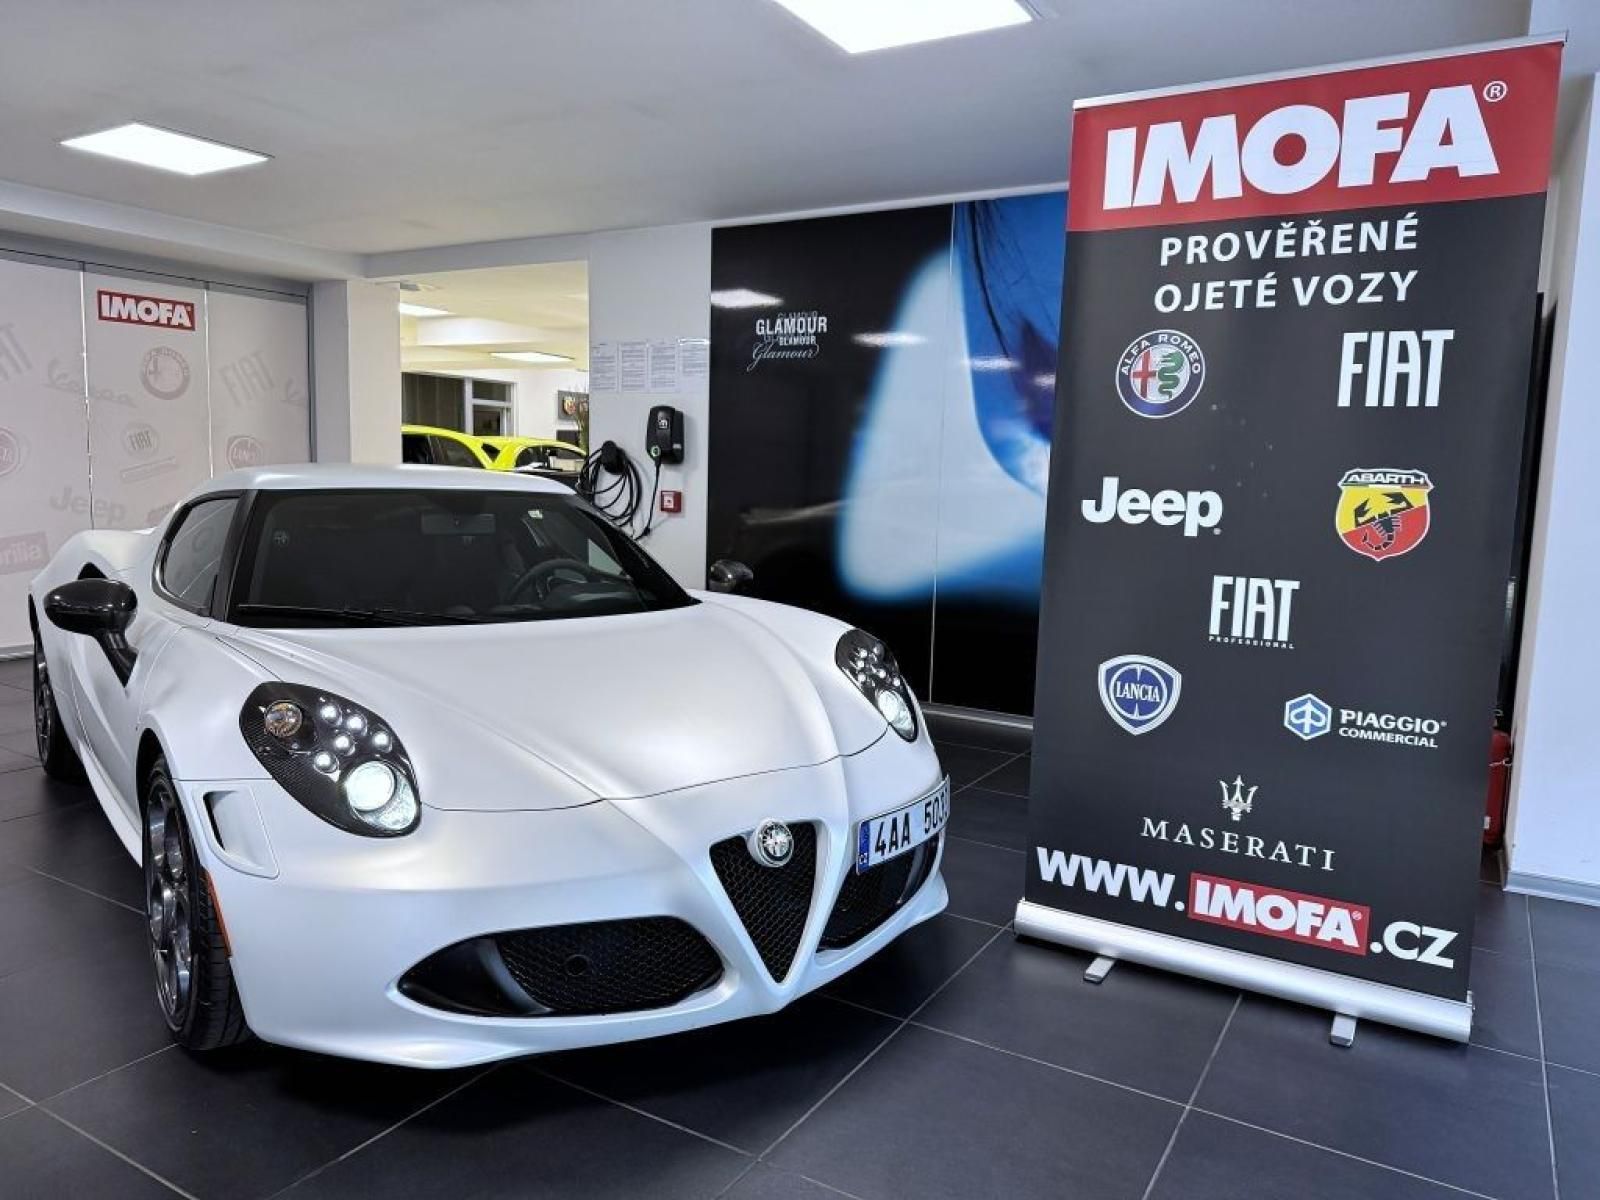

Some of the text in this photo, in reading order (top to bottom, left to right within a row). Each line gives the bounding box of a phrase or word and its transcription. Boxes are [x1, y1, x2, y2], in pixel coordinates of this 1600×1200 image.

[1160, 212, 1420, 267] PROVĚŘENÉ
[101, 294, 192, 328] IMOFA
[1154, 270, 1419, 313] OJETÉ VOZY
[756, 316, 828, 336] GLAMOUR
[1121, 334, 1201, 376] ALFA ROMEO
[1337, 329, 1455, 408] FIAT
[1347, 472, 1425, 485] ABARTH
[1081, 476, 1224, 538] Jeep
[1209, 575, 1300, 642] FIAT
[1115, 680, 1160, 702] LANCIA
[1338, 727, 1439, 748] COMMERCIAL
[1339, 708, 1441, 735] PIAGGIO
[1140, 816, 1337, 871] MASERATI
